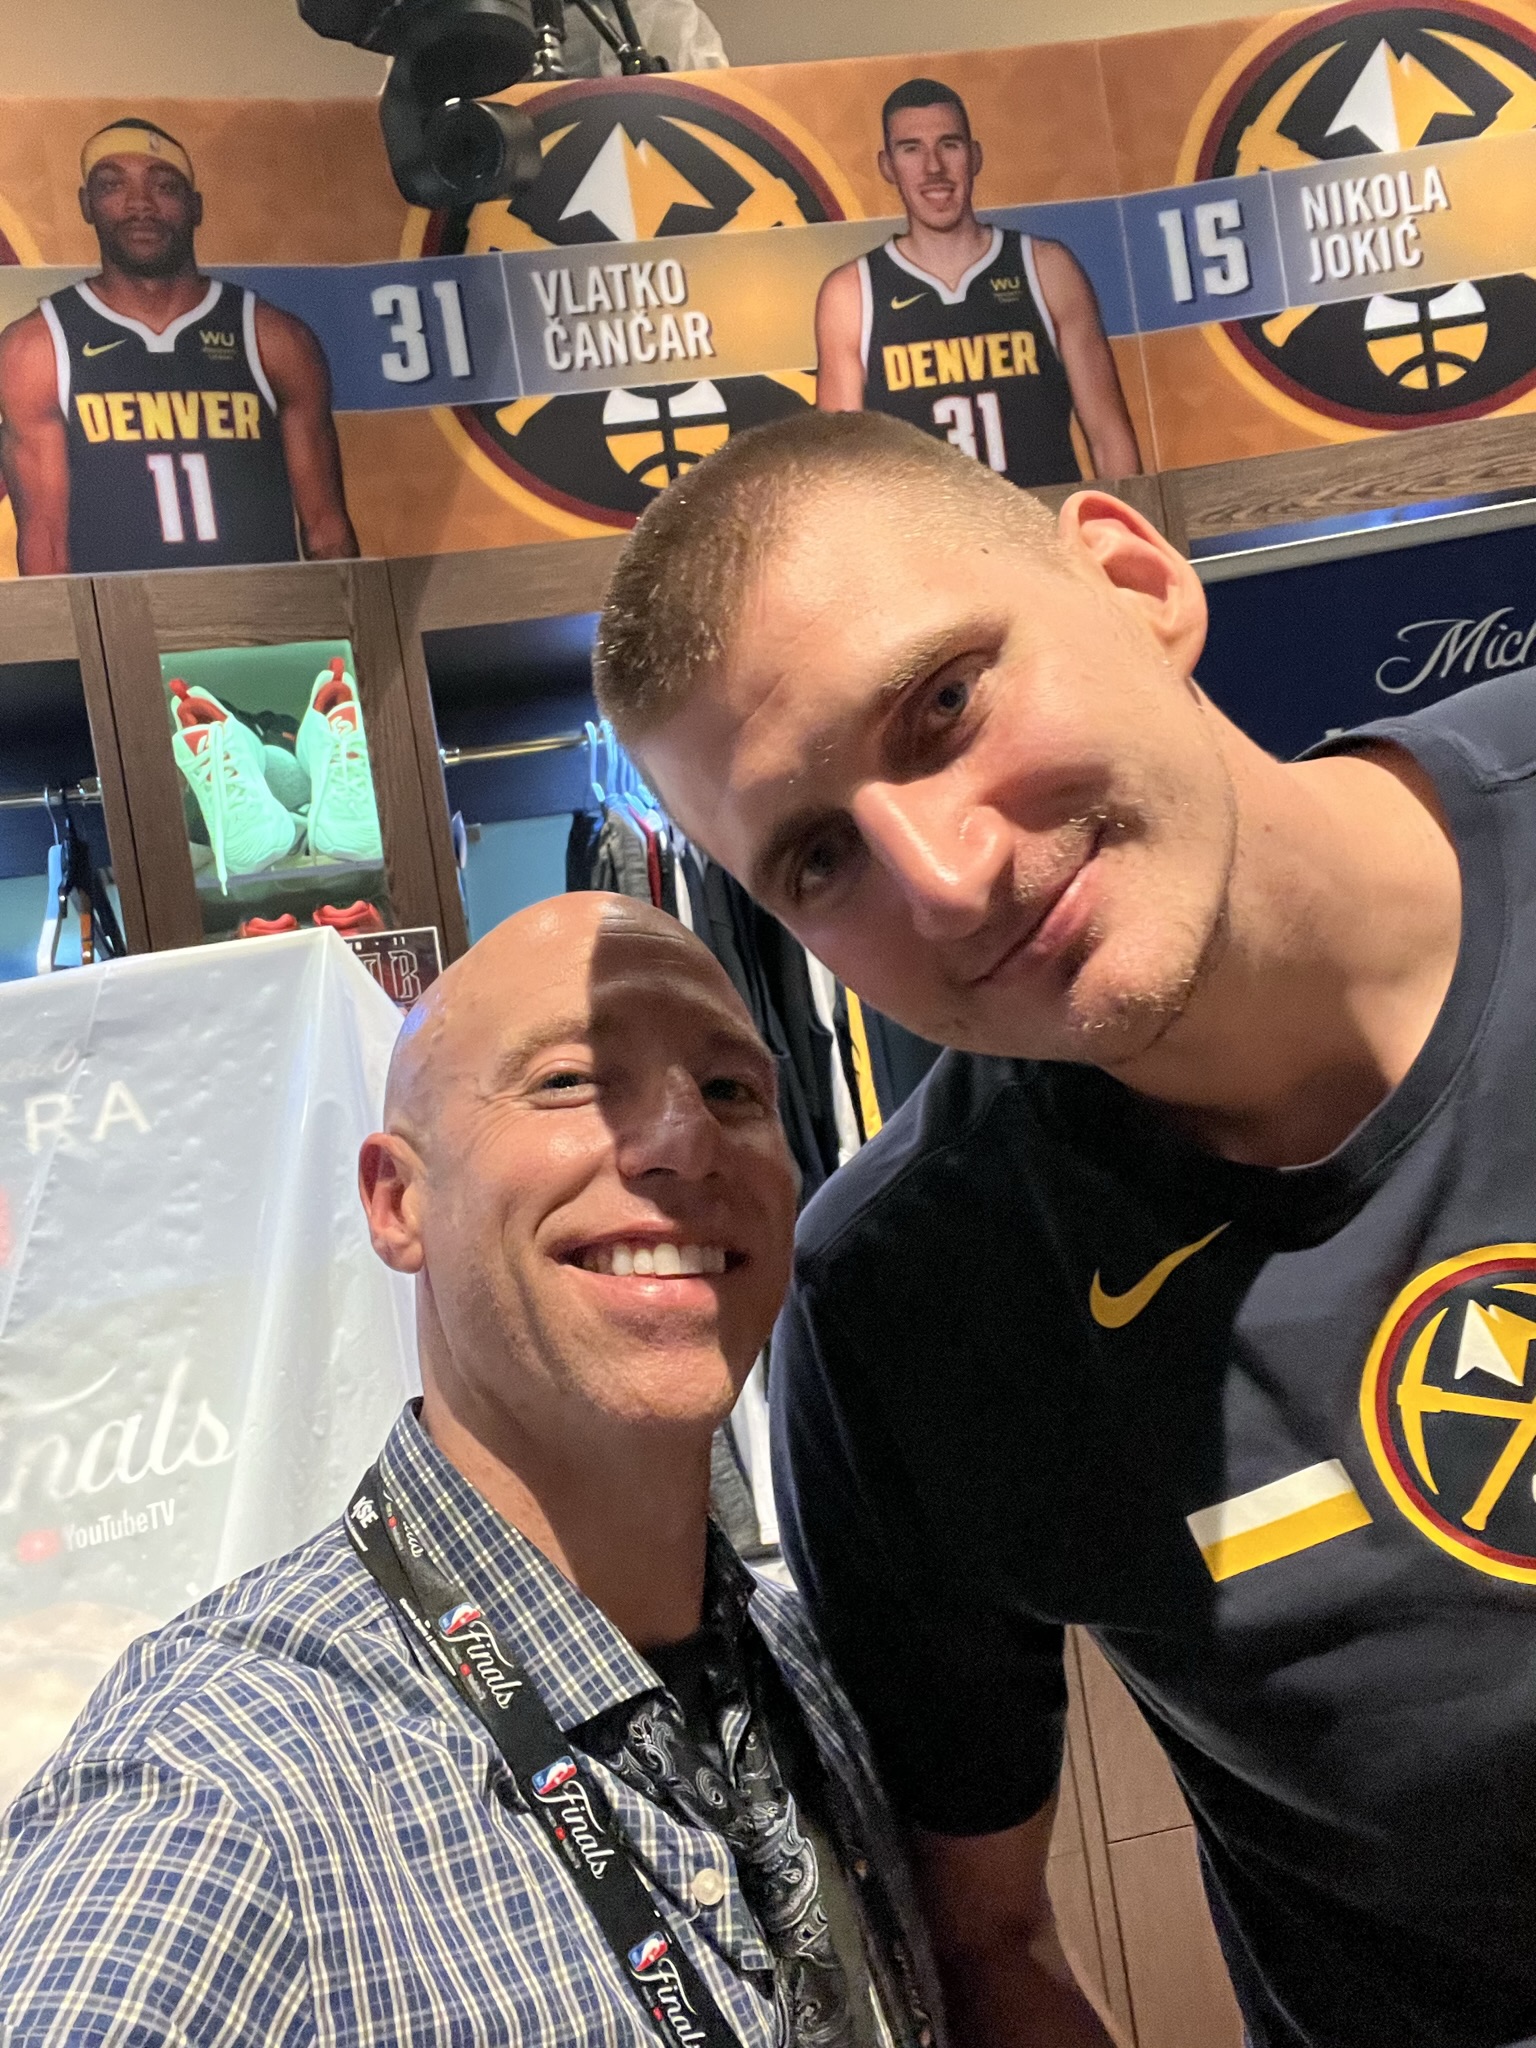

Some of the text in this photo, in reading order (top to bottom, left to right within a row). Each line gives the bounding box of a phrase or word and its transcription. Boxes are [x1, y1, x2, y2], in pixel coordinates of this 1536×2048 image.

[1301, 166, 1449, 231] NIKOLA
[1158, 199, 1250, 302] 15
[1309, 215, 1423, 283] JOKIĆ
[531, 258, 688, 316] VLATKO
[200, 330, 235, 347] WU
[371, 280, 470, 382] 31
[542, 309, 714, 371] ČANČAR
[882, 330, 1041, 391] DENVER
[75, 391, 261, 443] DENVER
[933, 392, 1007, 472] 31
[147, 453, 218, 542] 11
[0, 1080, 152, 1155] RA
[0, 1358, 235, 1512] nals
[439, 1621, 523, 1709] Finals
[533, 1780, 615, 1880] Finals
